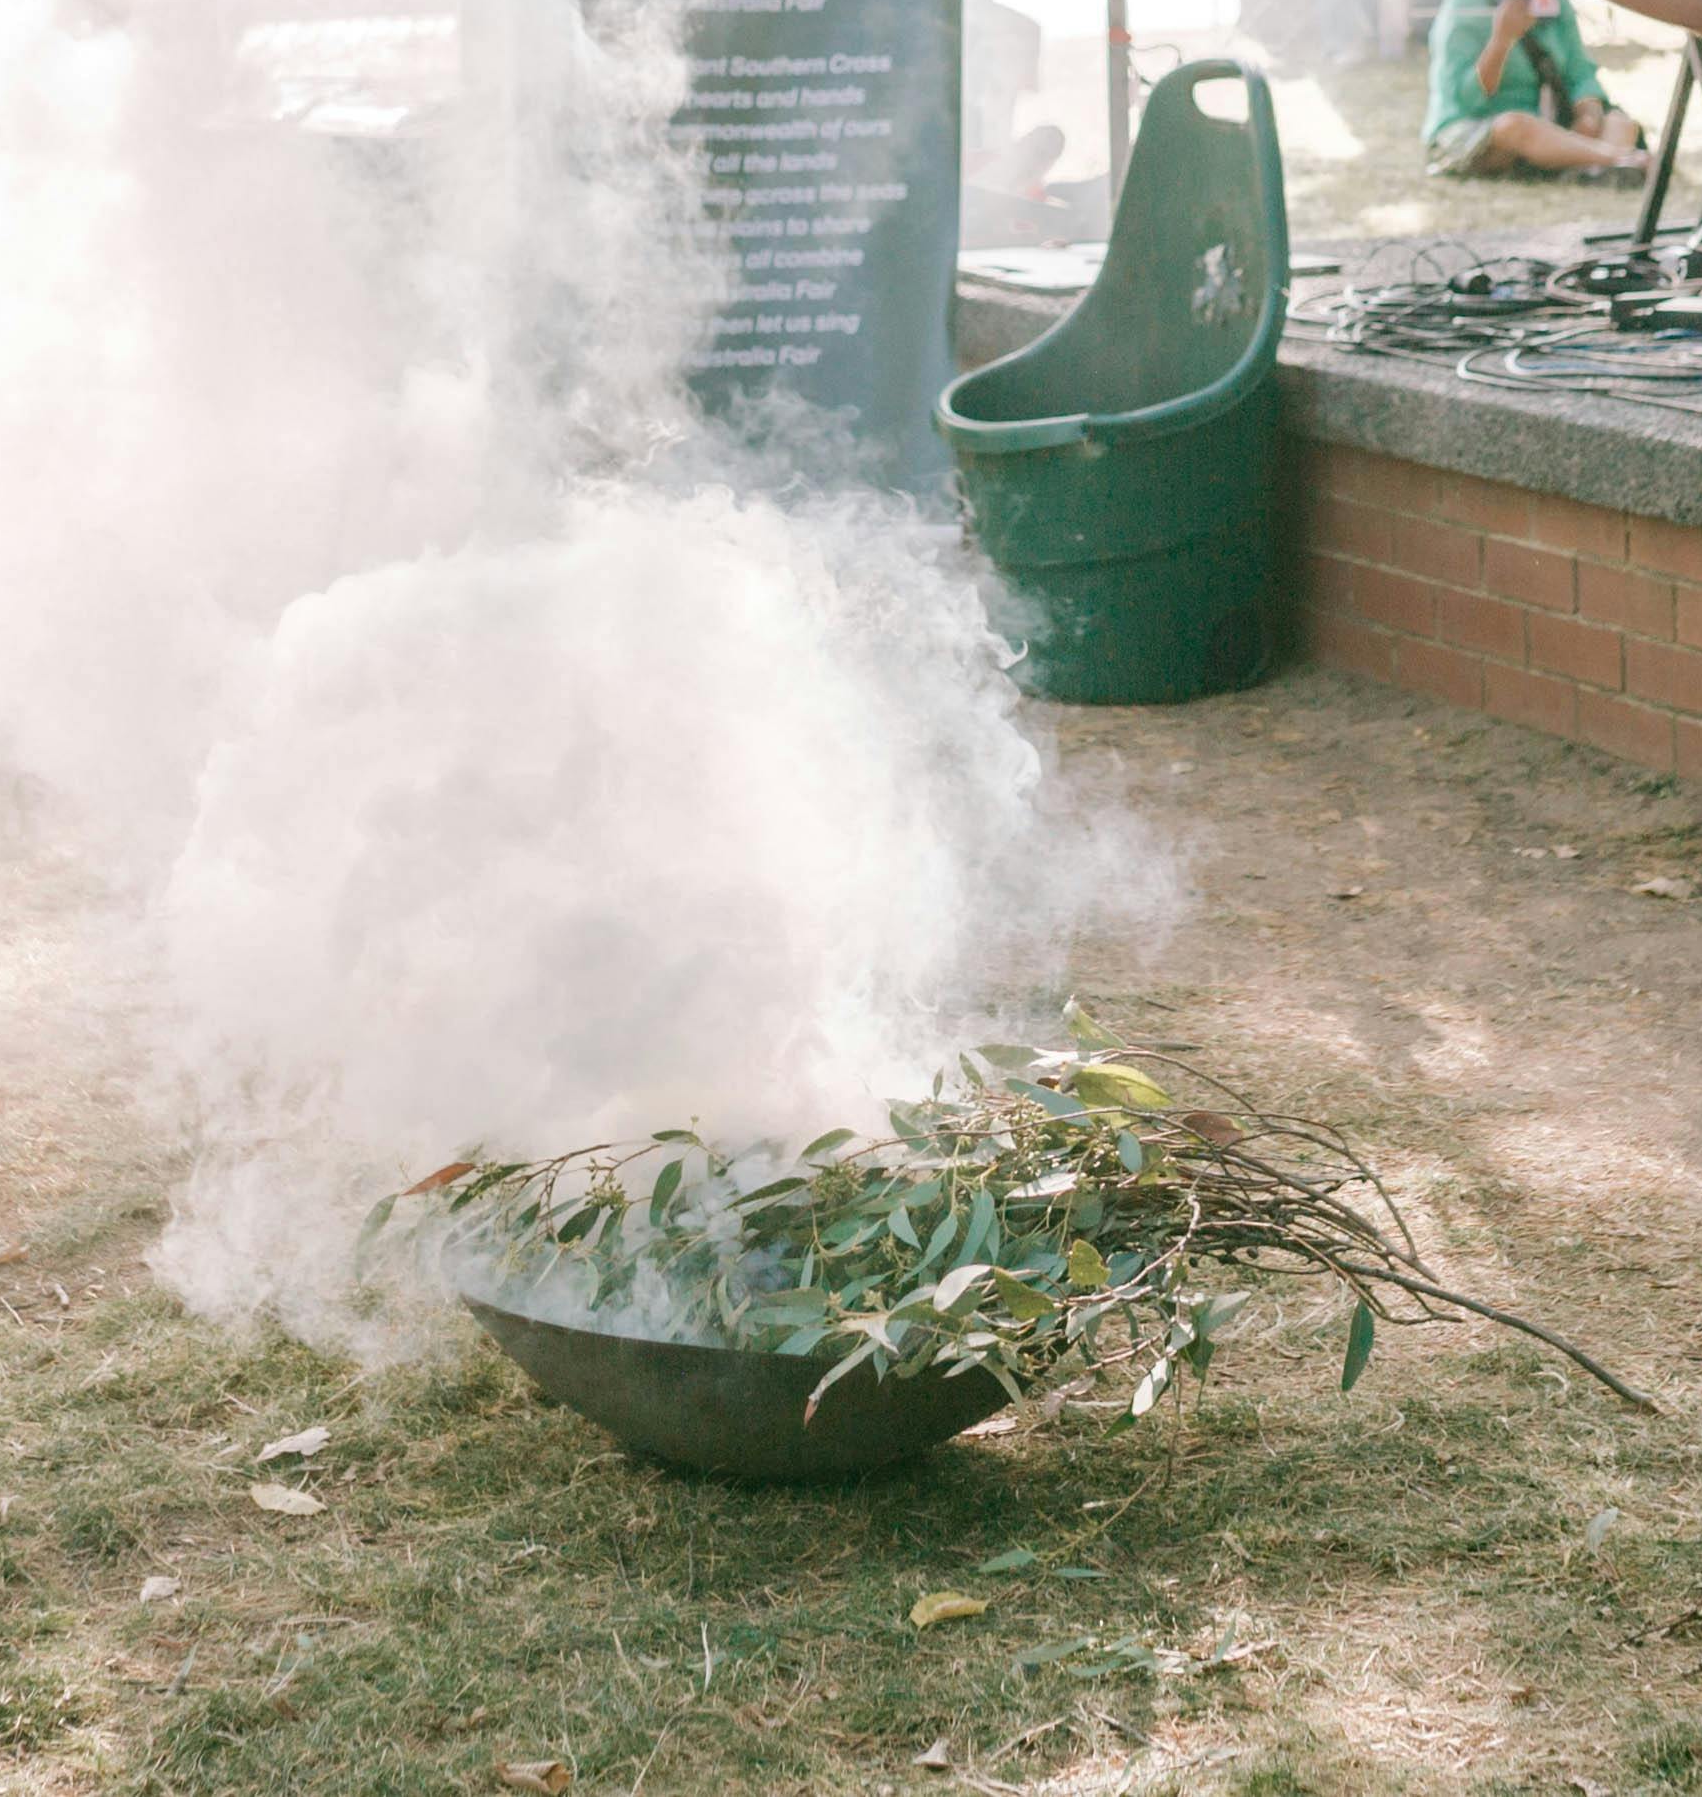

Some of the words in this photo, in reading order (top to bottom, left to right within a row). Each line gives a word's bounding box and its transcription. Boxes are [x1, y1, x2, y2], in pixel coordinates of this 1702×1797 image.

[730, 54, 826, 77] Southern
[829, 53, 893, 74] Cross
[755, 87, 799, 108] and
[800, 86, 866, 107] hands
[819, 116, 845, 141] of
[844, 119, 893, 139] ours
[712, 152, 742, 173] all
[742, 152, 777, 173] the
[778, 151, 840, 172] lands
[744, 186, 817, 207] across
[819, 183, 854, 203] the
[785, 217, 809, 237] to
[810, 214, 872, 236] share
[744, 248, 771, 269] all
[773, 247, 865, 269] combine
[794, 278, 839, 301] Fair
[755, 313, 784, 334] let
[785, 314, 812, 333] us
[814, 310, 862, 335] sing
[777, 345, 823, 366] Fair
